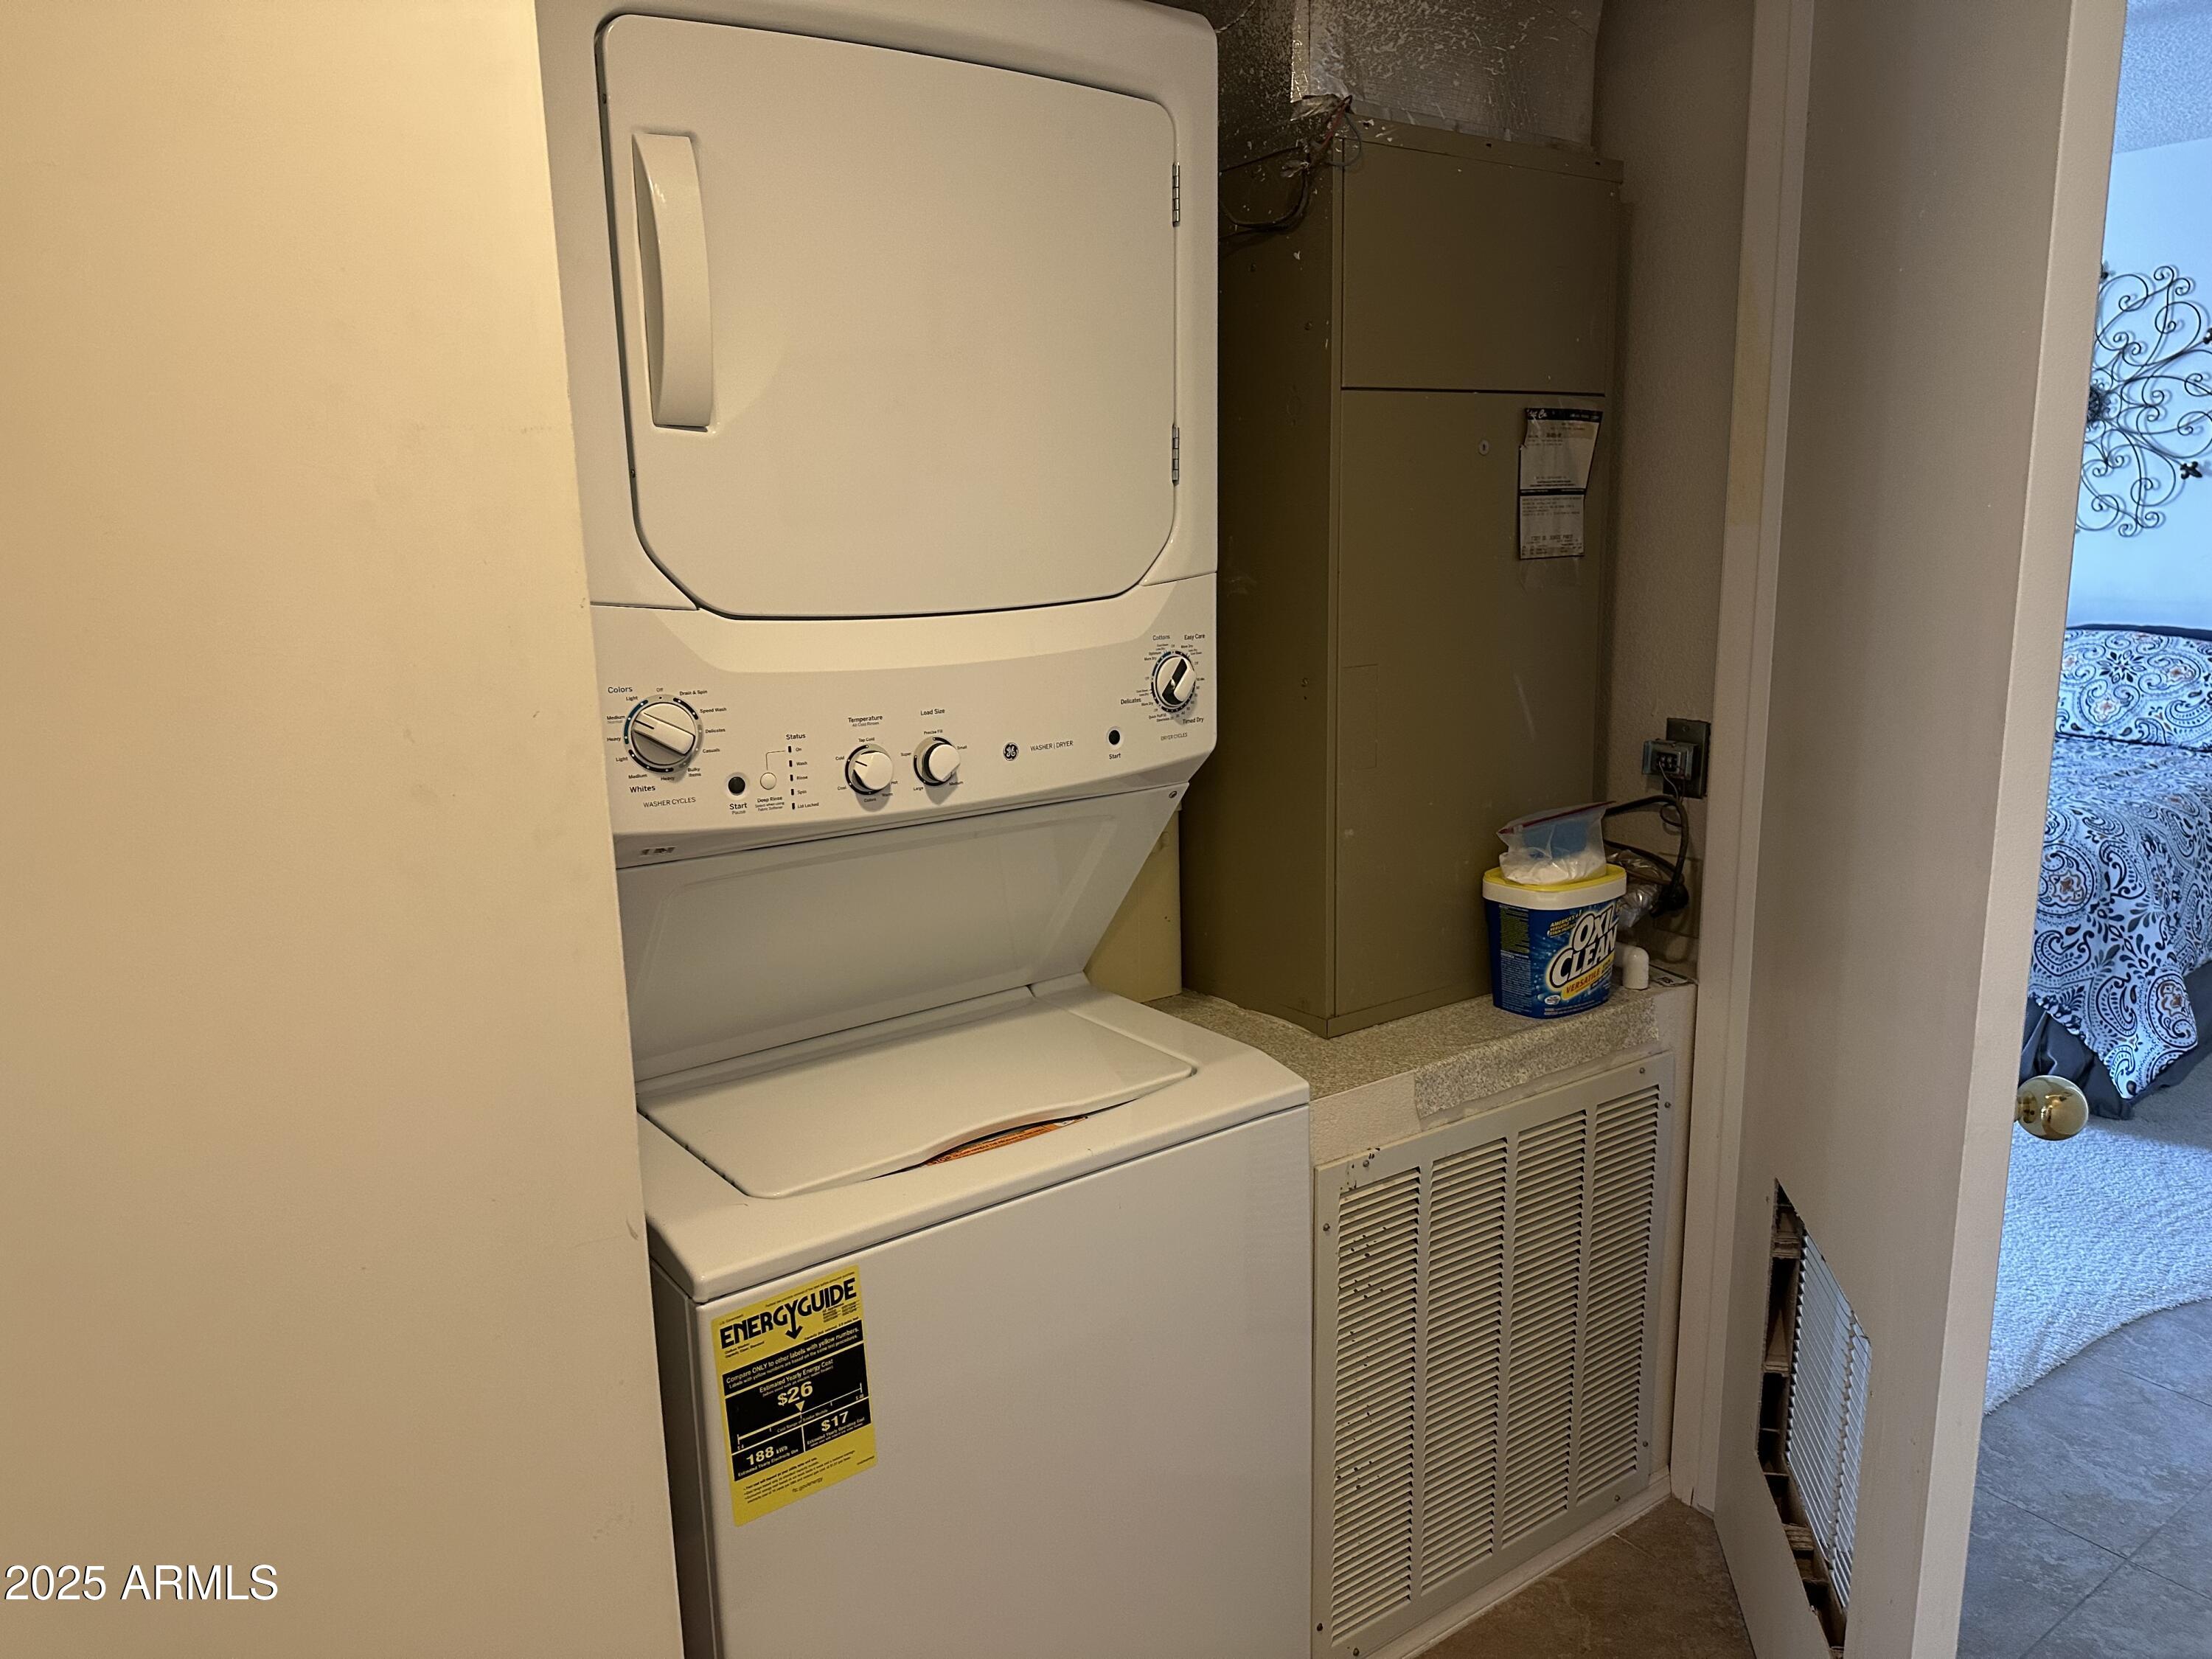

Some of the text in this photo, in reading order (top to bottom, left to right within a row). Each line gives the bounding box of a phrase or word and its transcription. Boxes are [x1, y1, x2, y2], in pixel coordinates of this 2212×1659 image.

[848, 715, 883, 723] Temperature
[1030, 740, 1074, 751] WASHER DRYER
[630, 785, 655, 793] Whites
[643, 796, 696, 807] WASHER CYCLES
[729, 802, 747, 810] Start
[1573, 904, 1619, 952] OXI
[1550, 925, 1617, 989] CLEAN
[1566, 968, 1600, 994] VERSATILE
[720, 1277, 857, 1349] ENERGYGUIDE
[726, 1371, 751, 1383] Compare
[752, 1363, 767, 1373] ONLY
[775, 1355, 789, 1364] other
[789, 1347, 805, 1359] labels
[807, 1343, 818, 1352] with
[818, 1338, 834, 1347] yellow
[836, 1328, 859, 1340] numbers.
[791, 1355, 803, 1363] based
[759, 1359, 833, 1393] Estimated Yearly Energy Cost
[778, 1381, 813, 1406] $26
[821, 1411, 848, 1431] $17
[807, 1433, 825, 1445] Estimated
[738, 1466, 757, 1477] Estimated
[771, 1453, 790, 1463] Electricity
[746, 1446, 787, 1465] 188 kWh
